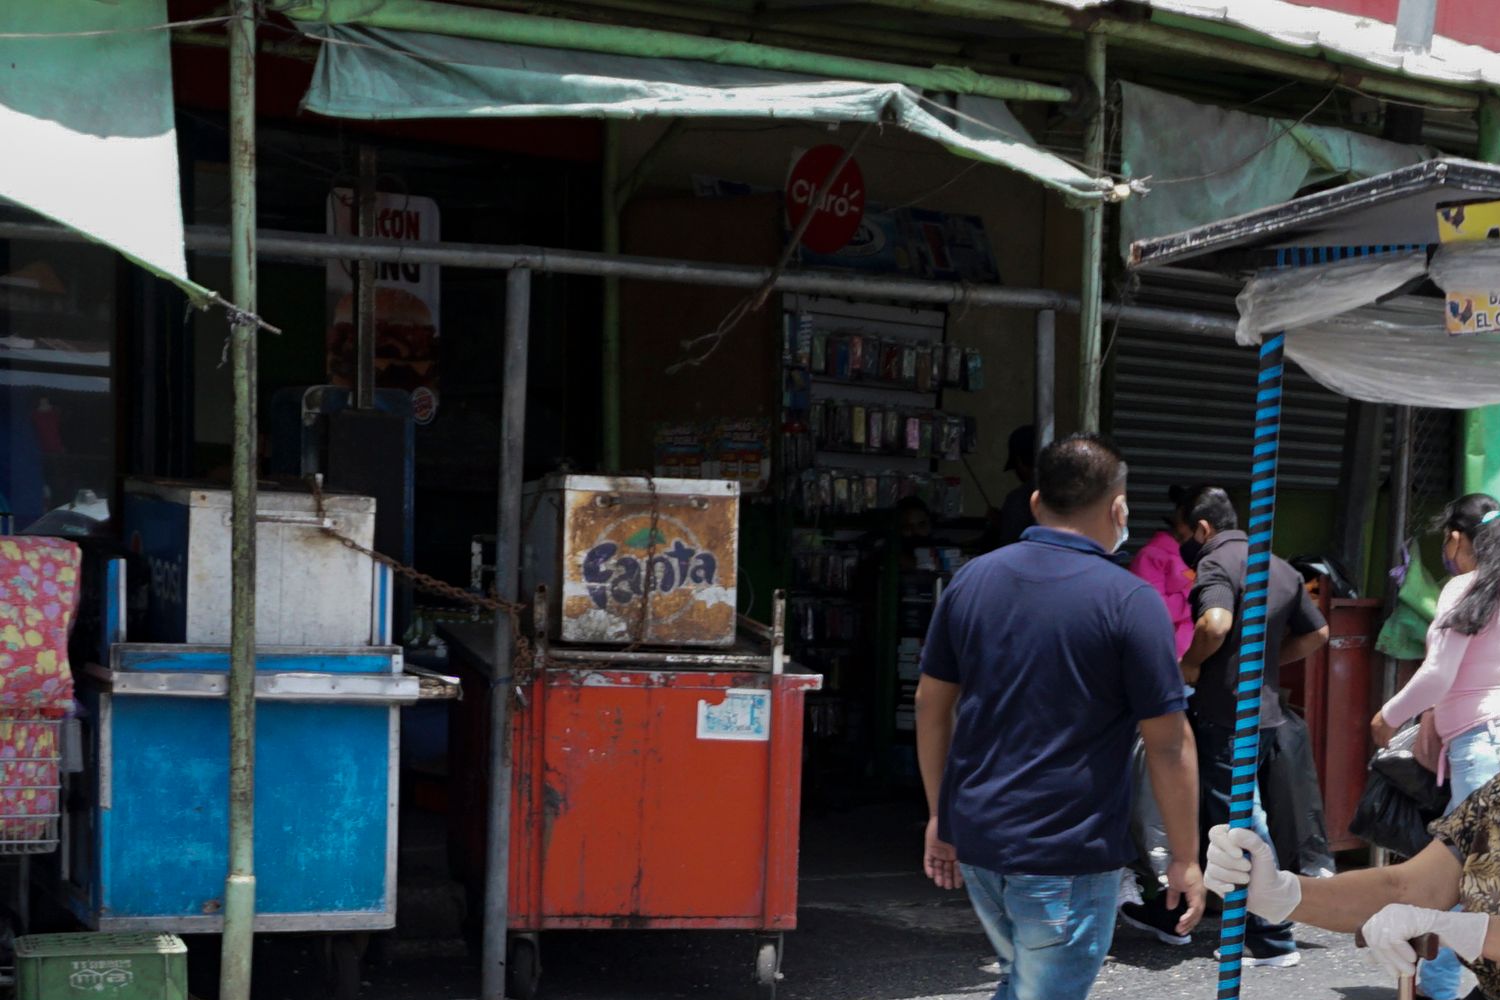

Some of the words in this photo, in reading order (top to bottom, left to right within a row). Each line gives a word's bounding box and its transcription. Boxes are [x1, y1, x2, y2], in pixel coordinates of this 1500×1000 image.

[792, 179, 850, 218] Claro
[1476, 313, 1491, 328] EL
[583, 540, 717, 610] Fanta
